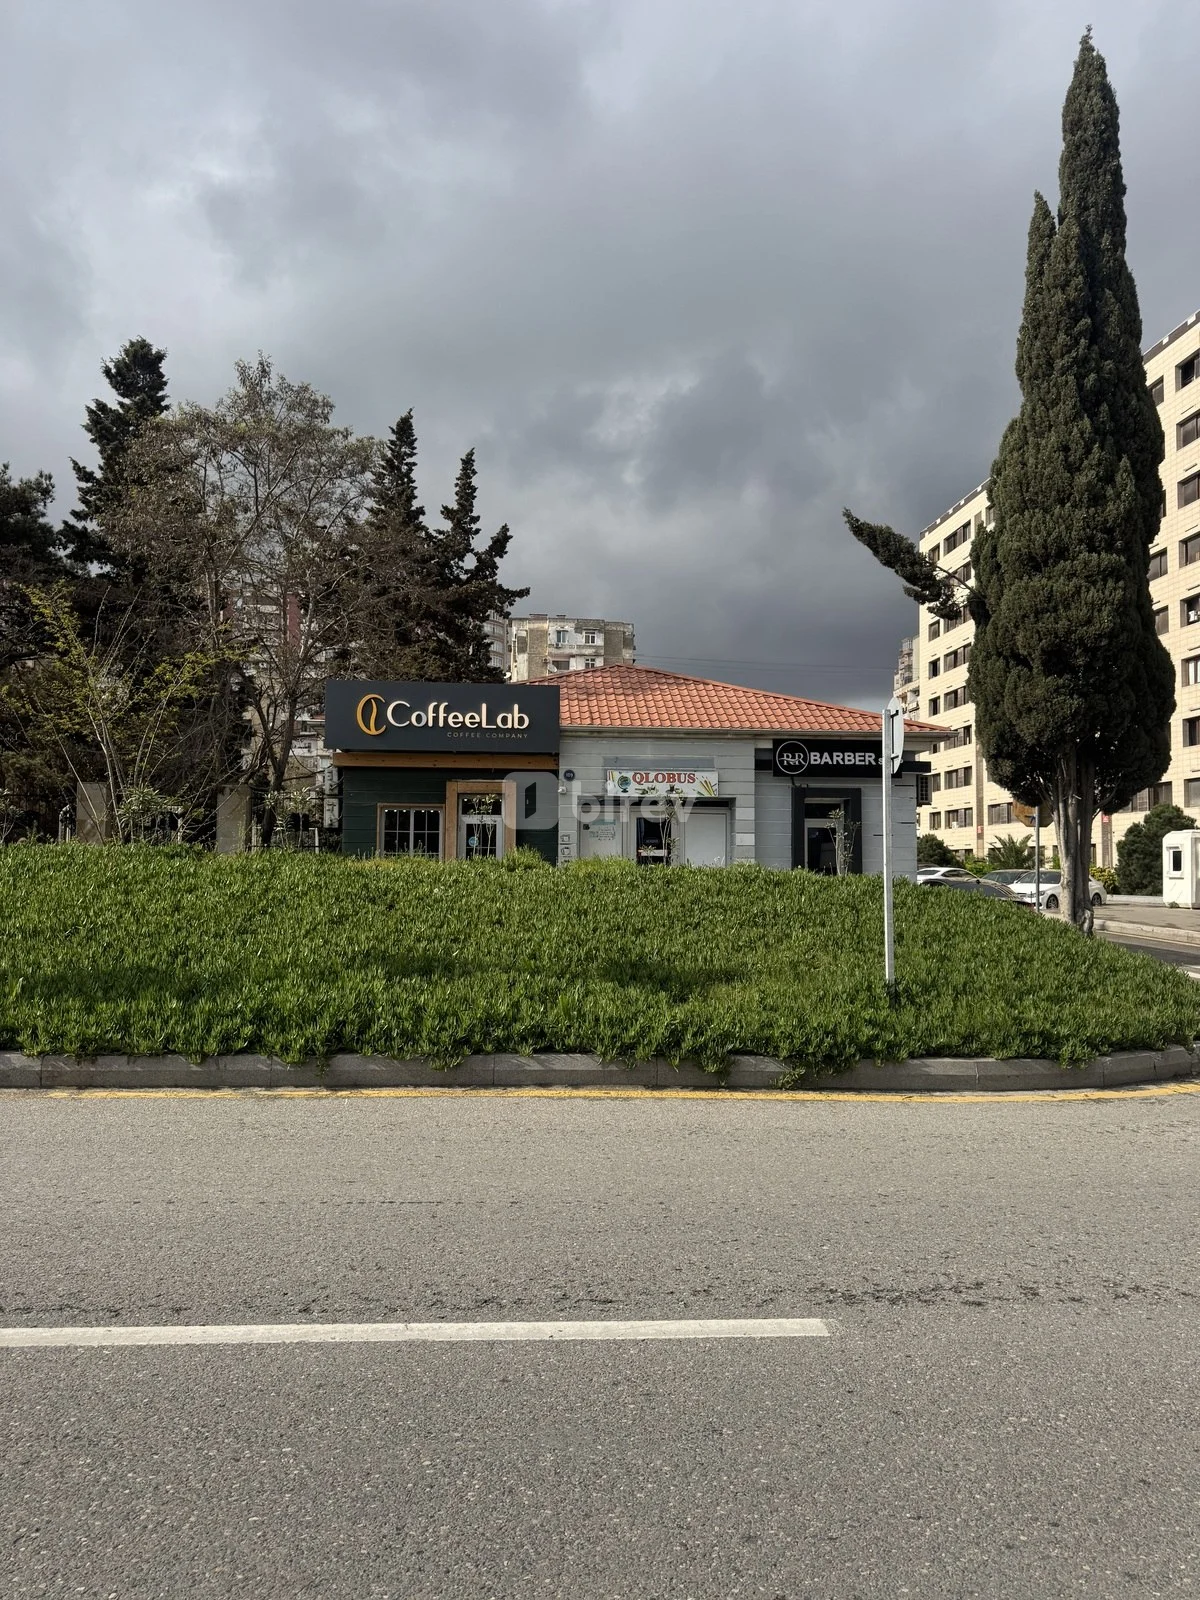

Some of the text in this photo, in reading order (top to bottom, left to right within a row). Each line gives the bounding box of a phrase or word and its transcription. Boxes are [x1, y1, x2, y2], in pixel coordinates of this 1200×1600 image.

[386, 700, 530, 730] CoffeeLab
[447, 731, 529, 740] COFFEE COMPANY
[810, 752, 876, 766] BARBER
[631, 772, 697, 786] QLOBUS
